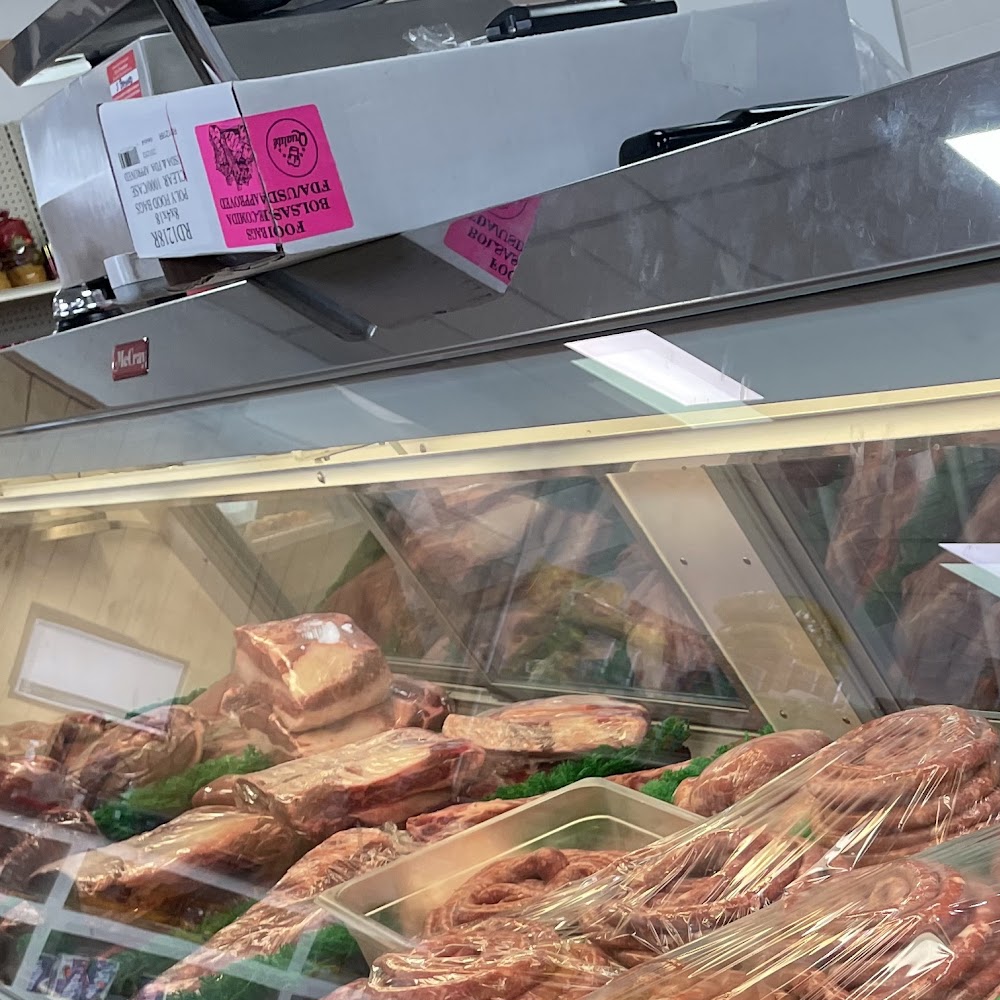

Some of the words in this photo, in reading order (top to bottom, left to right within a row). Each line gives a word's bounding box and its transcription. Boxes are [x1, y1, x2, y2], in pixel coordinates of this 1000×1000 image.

[124, 166, 149, 182] APPROVED
[152, 193, 170, 209] FOOD
[170, 188, 189, 206] POLY
[220, 194, 260, 210] APPROVED
[135, 199, 152, 214] BAGS
[272, 198, 331, 220] BOLSAS
[155, 207, 179, 225] 8x4x18
[150, 222, 193, 249] RD1218R
[245, 227, 267, 241] BAGS
